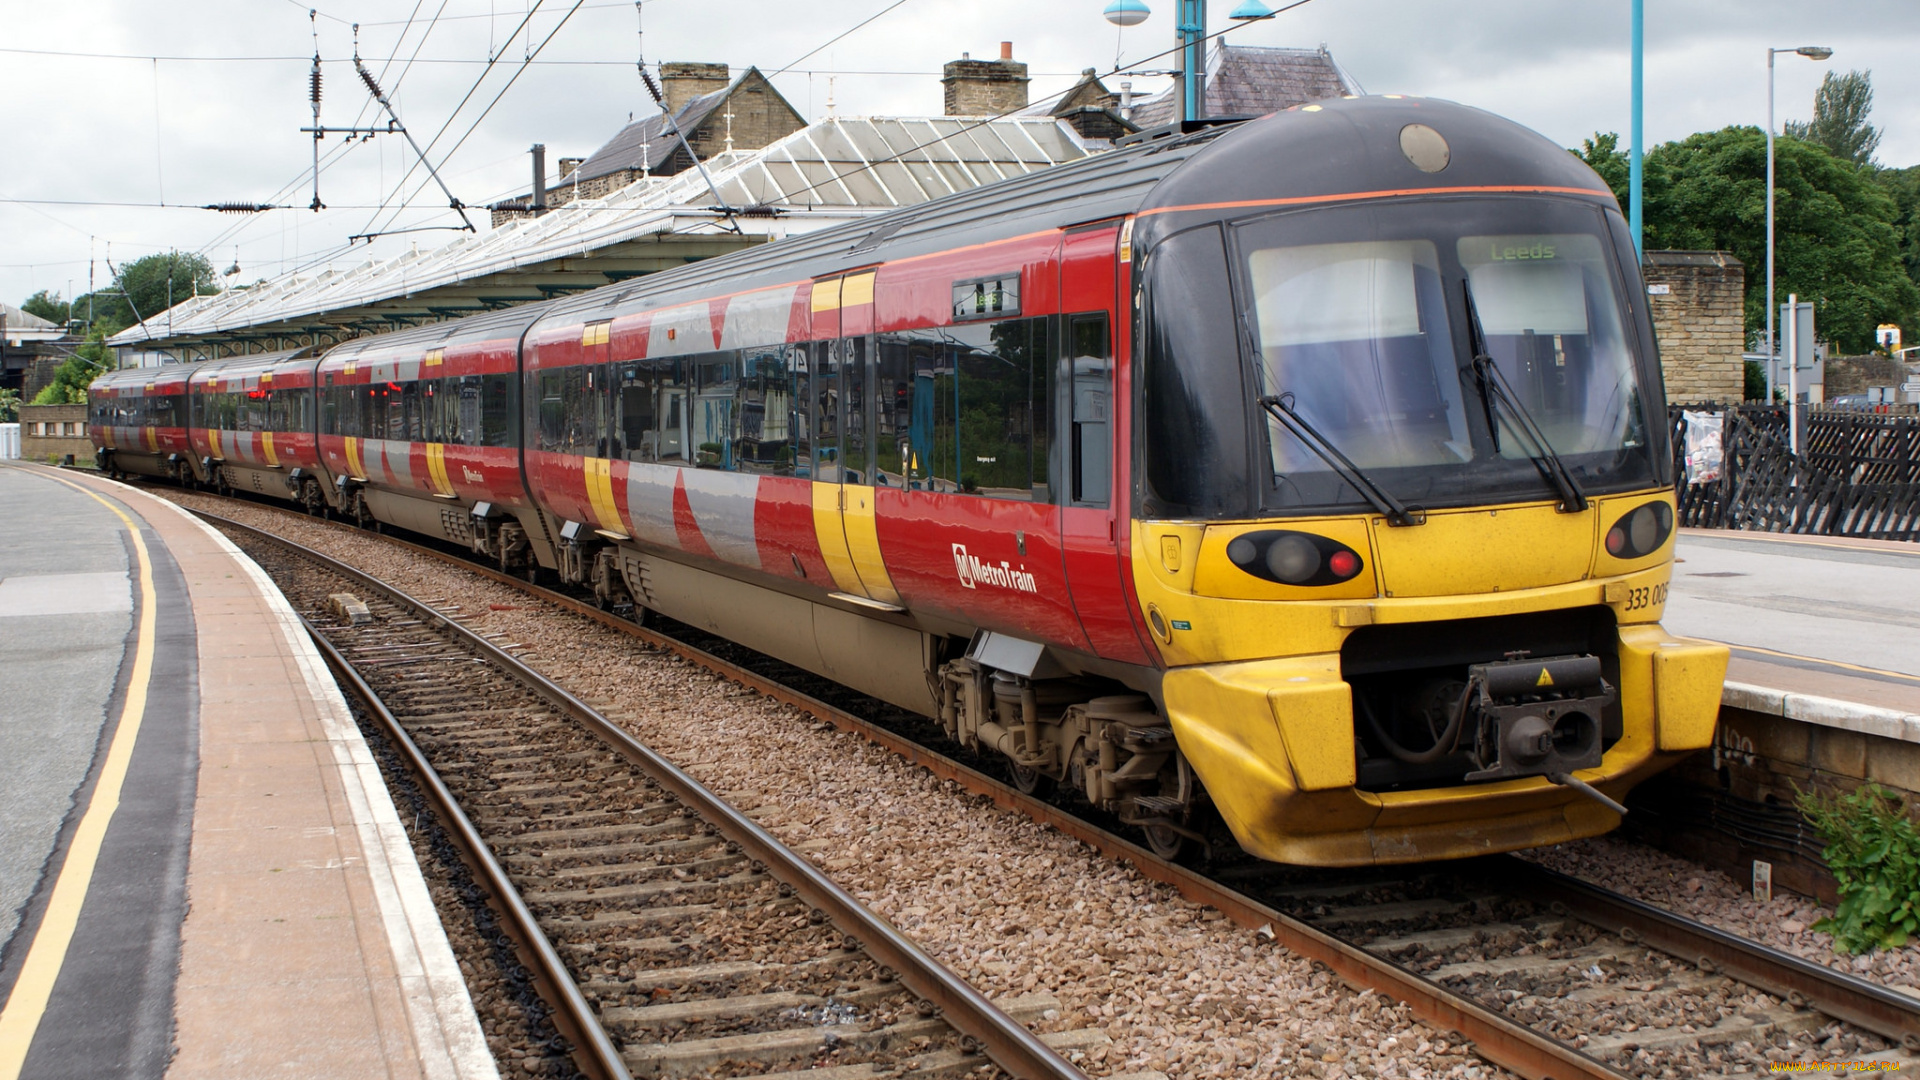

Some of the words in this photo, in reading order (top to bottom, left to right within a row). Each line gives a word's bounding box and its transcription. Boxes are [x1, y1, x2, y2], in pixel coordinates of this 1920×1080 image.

[1491, 243, 1556, 260] Leeds
[968, 554, 1037, 593] MetroTrain
[1625, 586, 1650, 612] 333
